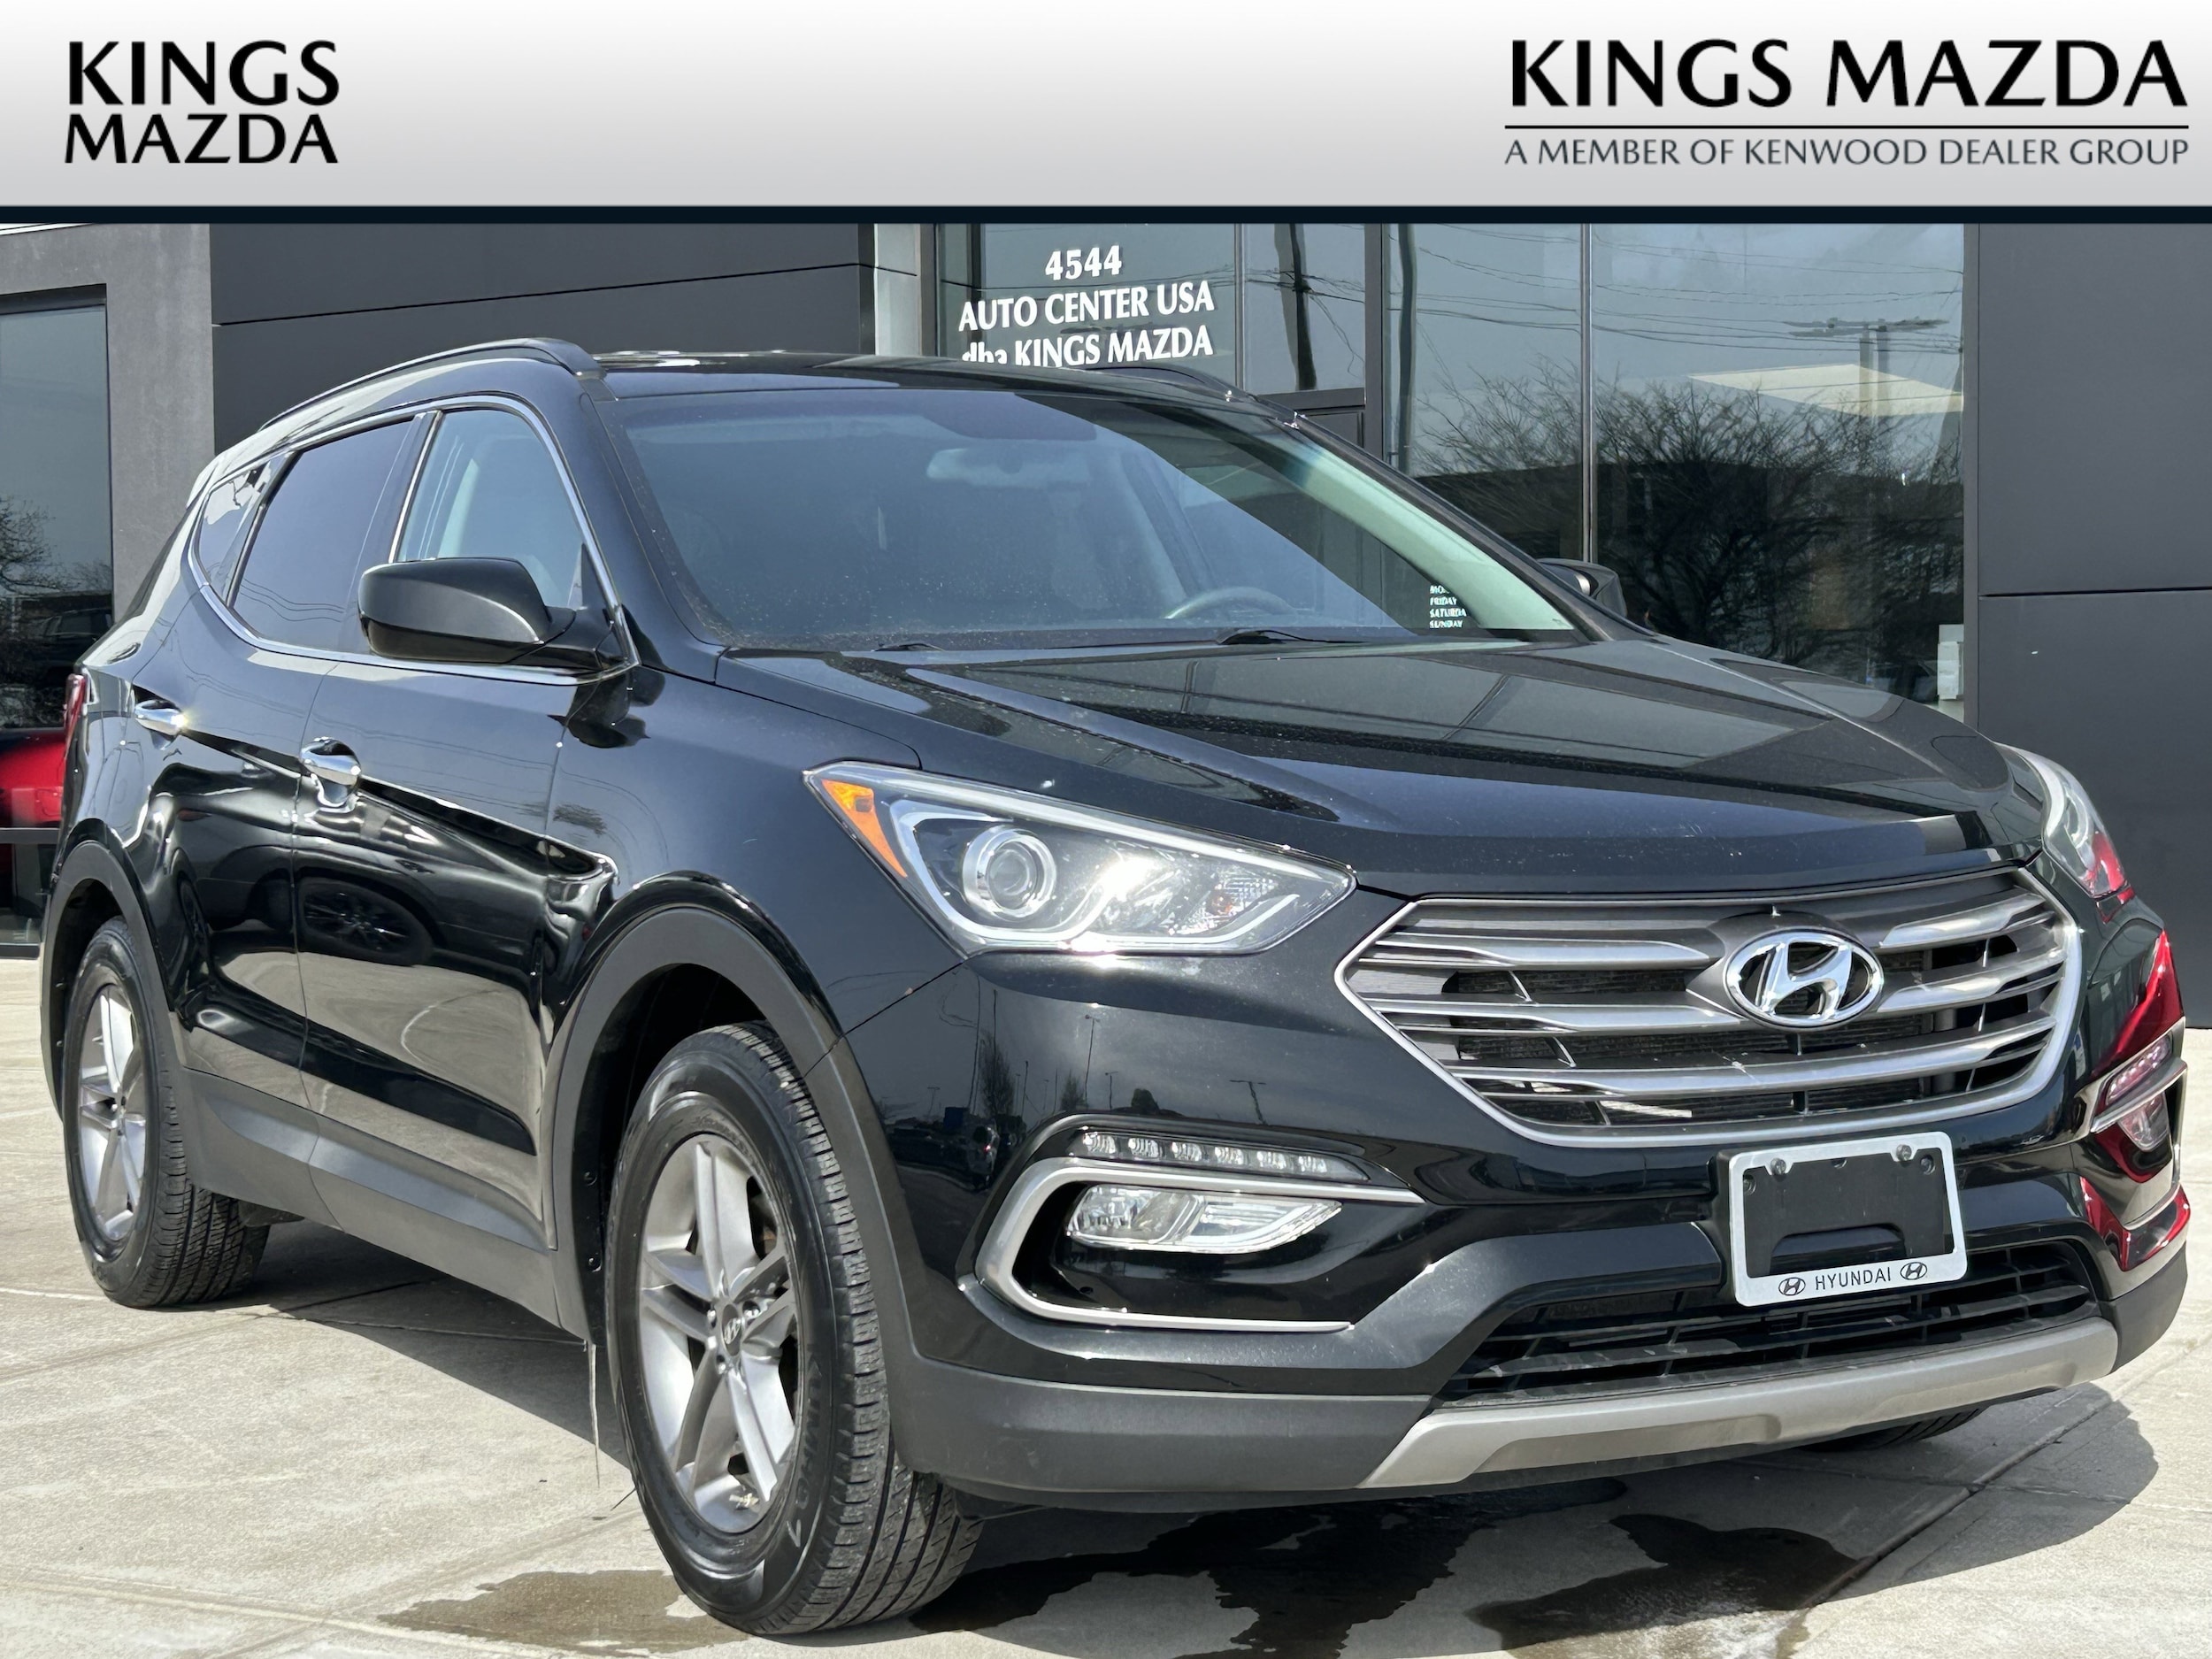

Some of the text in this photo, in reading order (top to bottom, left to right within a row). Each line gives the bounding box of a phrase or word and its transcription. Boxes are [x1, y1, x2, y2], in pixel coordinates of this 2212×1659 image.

[1045, 246, 1121, 280] 4544
[958, 280, 1215, 332] AUTO CENTER USA
[1015, 334, 1101, 368] KINGS
[1108, 324, 1214, 364] MAZDA
[1430, 585, 1449, 594] MO
[1430, 596, 1457, 606] FRIDAY
[1430, 608, 1467, 618] SATURDA
[1430, 619, 1463, 628] SUNDAY
[1815, 1266, 1892, 1291] HYUNDAI
